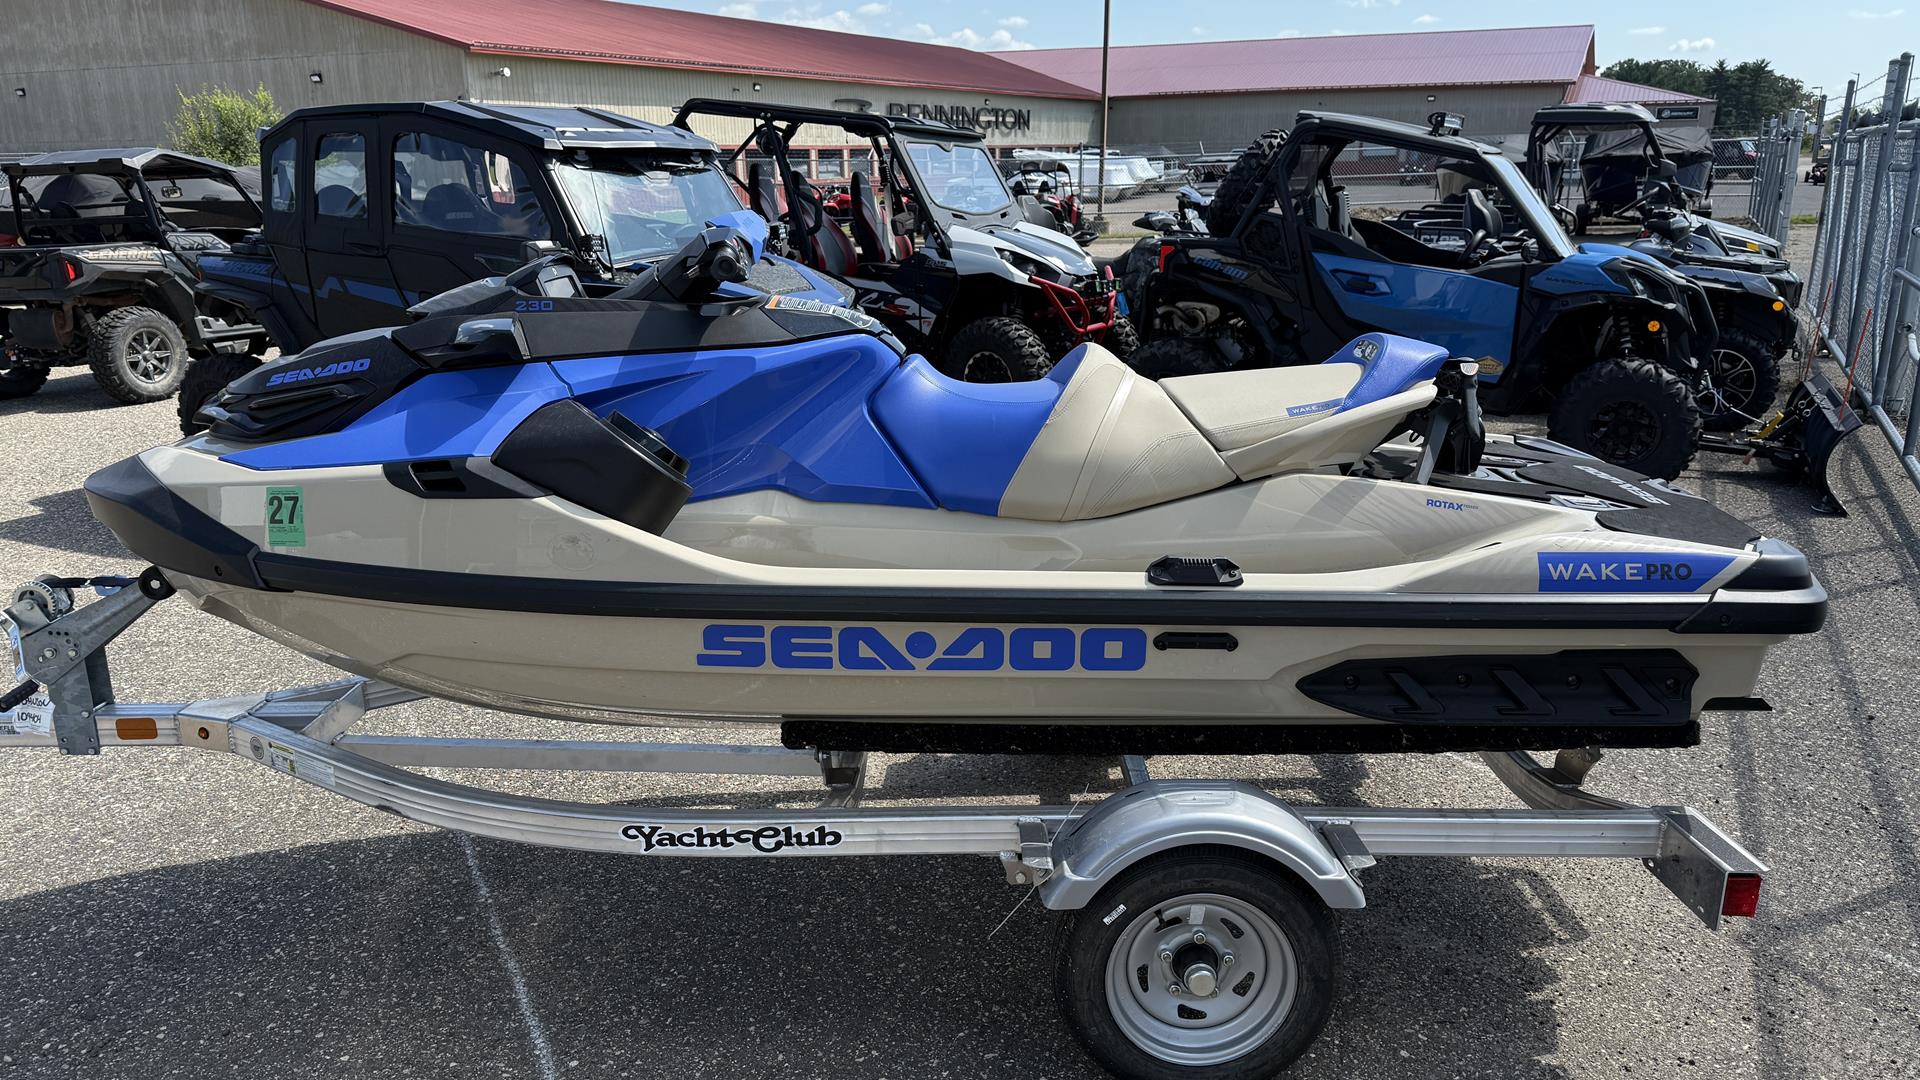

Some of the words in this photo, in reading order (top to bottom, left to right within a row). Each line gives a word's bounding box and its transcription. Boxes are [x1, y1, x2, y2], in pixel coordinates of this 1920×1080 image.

[888, 102, 1031, 131] BENNINGTON
[88, 249, 156, 260] GENERAL
[515, 301, 553, 311] 230
[268, 496, 299, 525] 27
[1426, 498, 1464, 511] ROTAX
